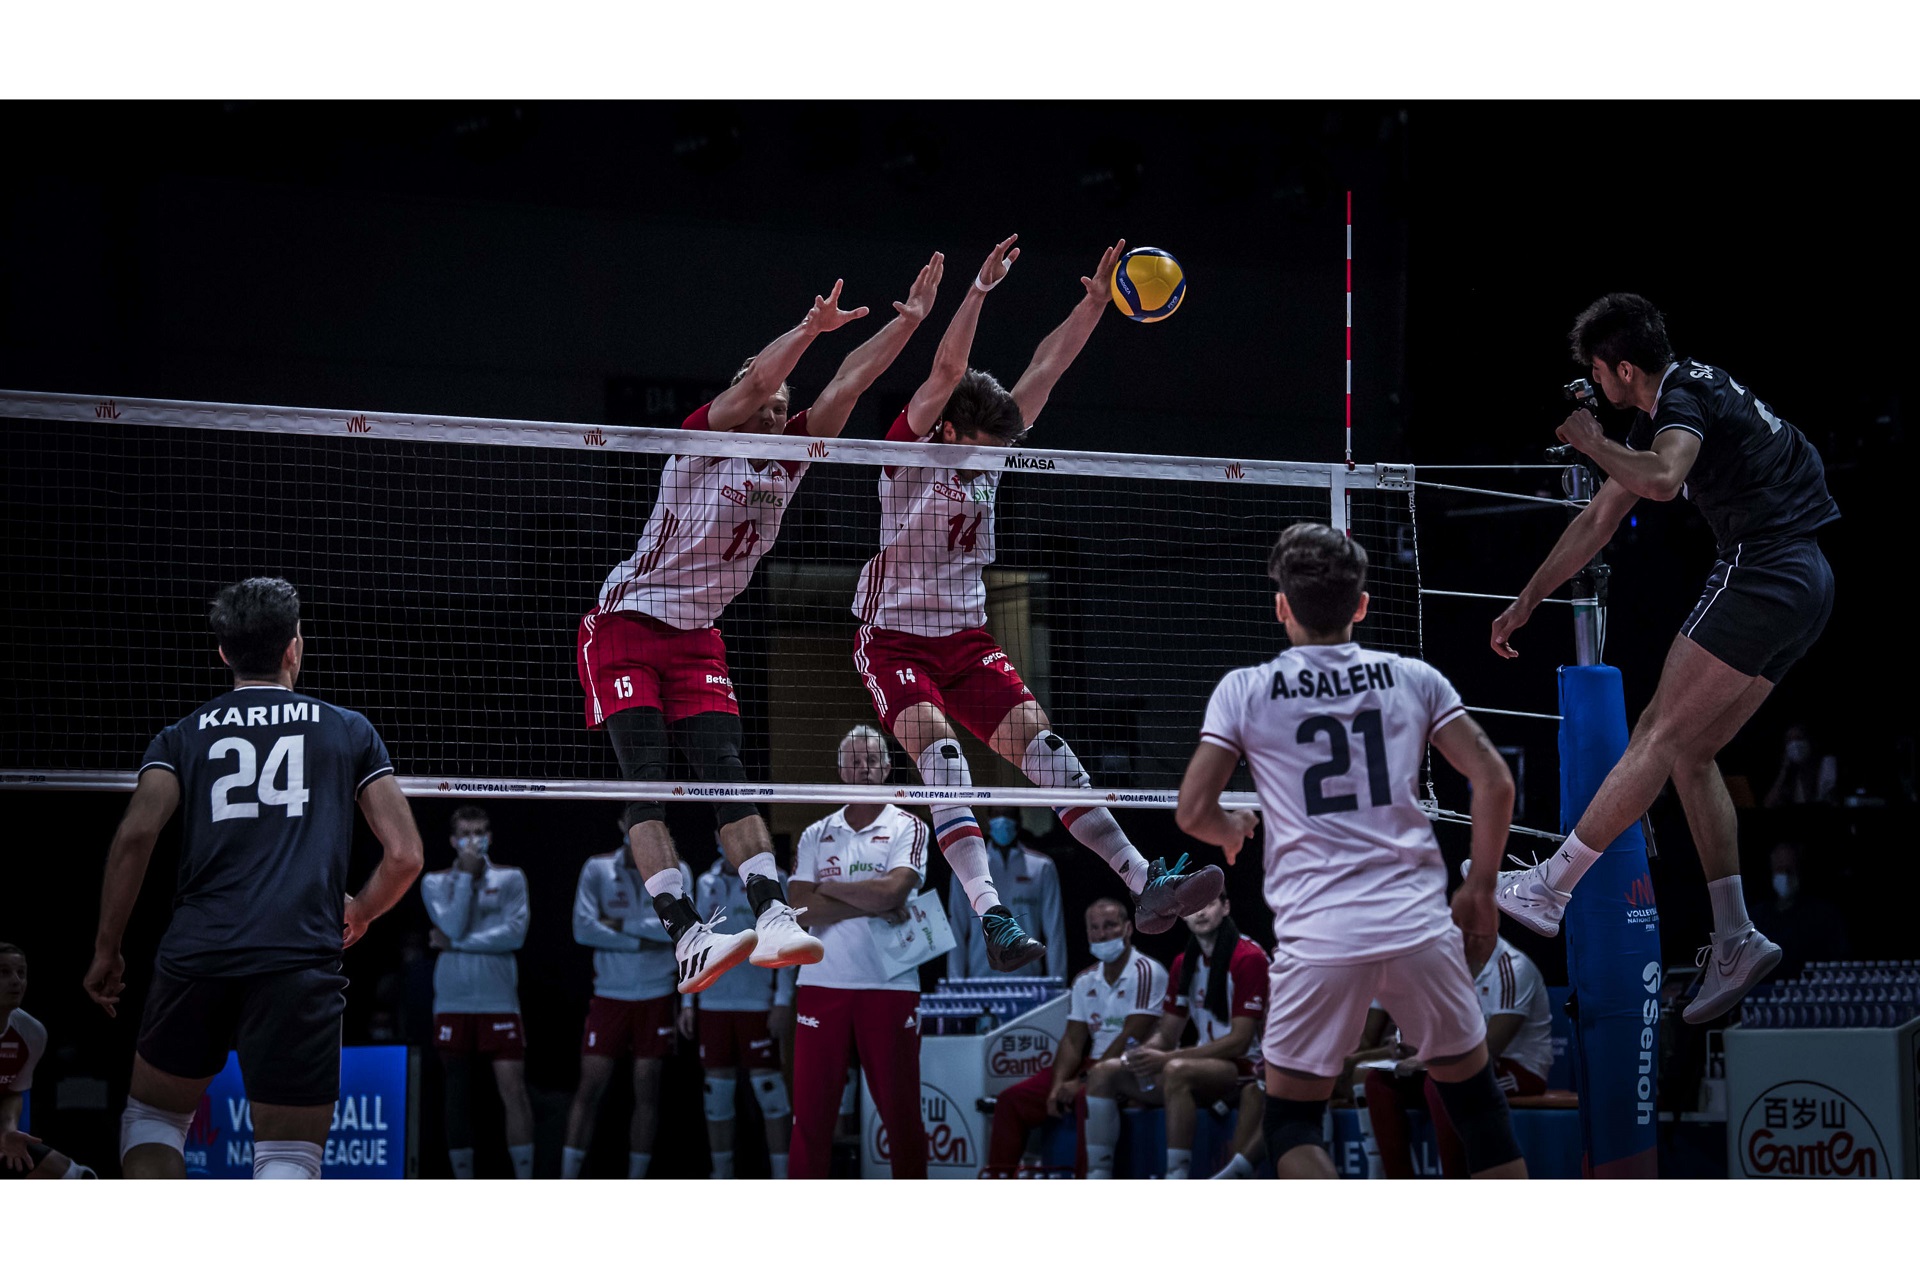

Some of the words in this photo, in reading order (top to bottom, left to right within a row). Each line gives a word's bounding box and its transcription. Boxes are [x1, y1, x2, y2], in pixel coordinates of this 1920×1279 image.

[95, 400, 121, 420] VNL
[346, 414, 371, 433] VNL
[583, 428, 607, 447] VNL
[807, 440, 829, 458] VNL
[1224, 462, 1245, 480] VNL
[722, 486, 747, 506] ORLE
[751, 490, 784, 508] plus
[947, 511, 982, 553] 14
[896, 668, 916, 685] 14
[1271, 663, 1395, 700] A.SALEHI
[614, 675, 634, 700] 15
[198, 702, 320, 730] KARIMI
[1296, 709, 1392, 817] 21
[208, 734, 310, 823] 24
[454, 783, 509, 792] VOLLEYBALL
[688, 788, 739, 796] VOLLEYBALL
[909, 791, 957, 799] VOLLEYBALL
[1119, 794, 1167, 803] VOLLEYBALL
[849, 860, 873, 875] plus
[1002, 1036, 1049, 1052] 百岁山
[992, 1051, 1052, 1075] Gante
[1637, 999, 1659, 1125] Senoh
[1764, 1098, 1846, 1130] 百岁山
[324, 1139, 389, 1167] EAGUE
[1748, 1129, 1877, 1178] Ganten
